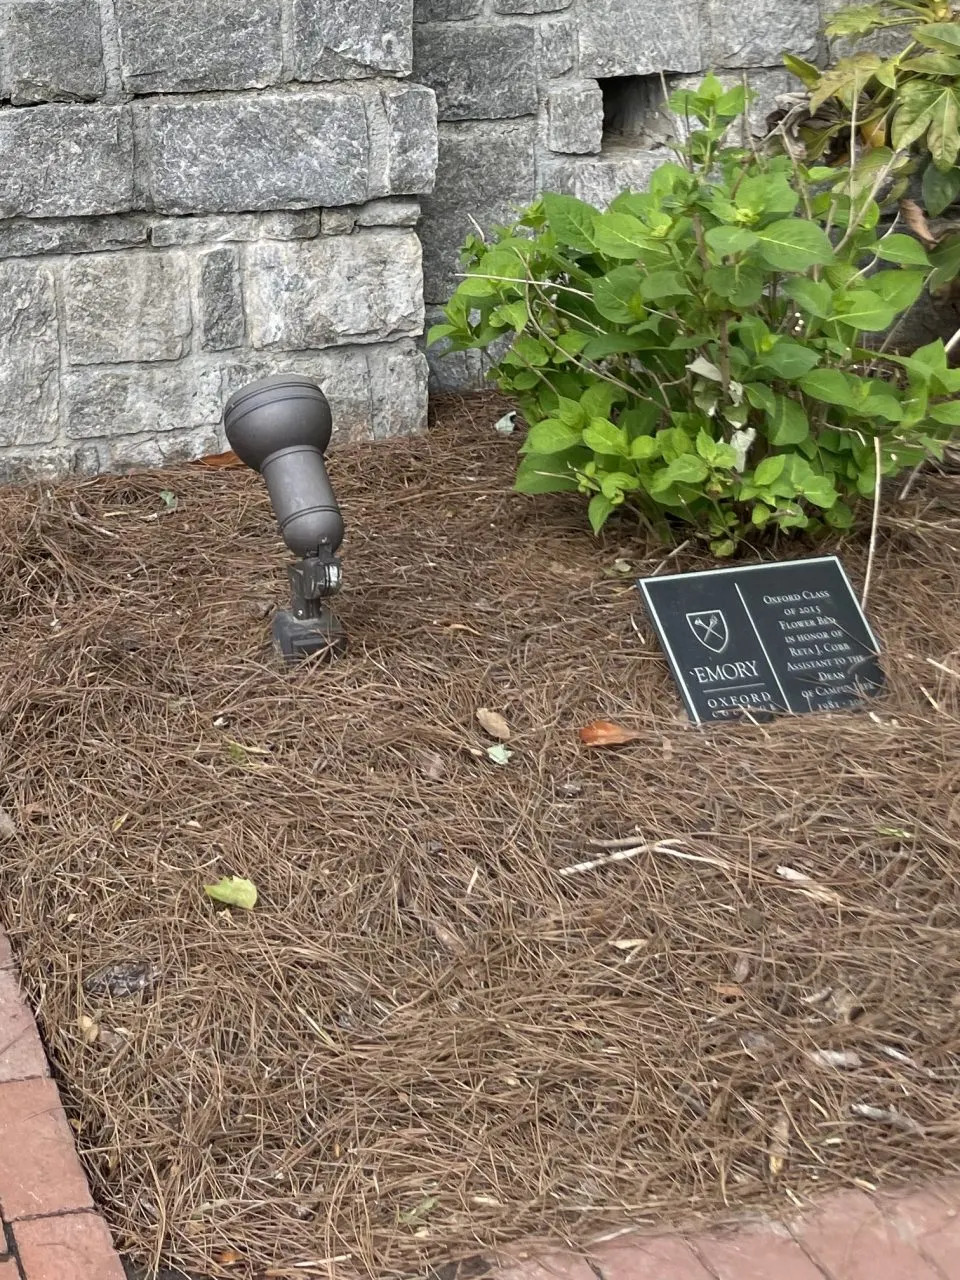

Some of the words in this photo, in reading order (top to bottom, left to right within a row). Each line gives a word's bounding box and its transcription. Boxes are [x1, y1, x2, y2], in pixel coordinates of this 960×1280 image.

[802, 590, 830, 600] CLASS
[799, 605, 822, 614] 2015
[693, 660, 759, 683] EMORY
[707, 691, 772, 709] OXFORD
